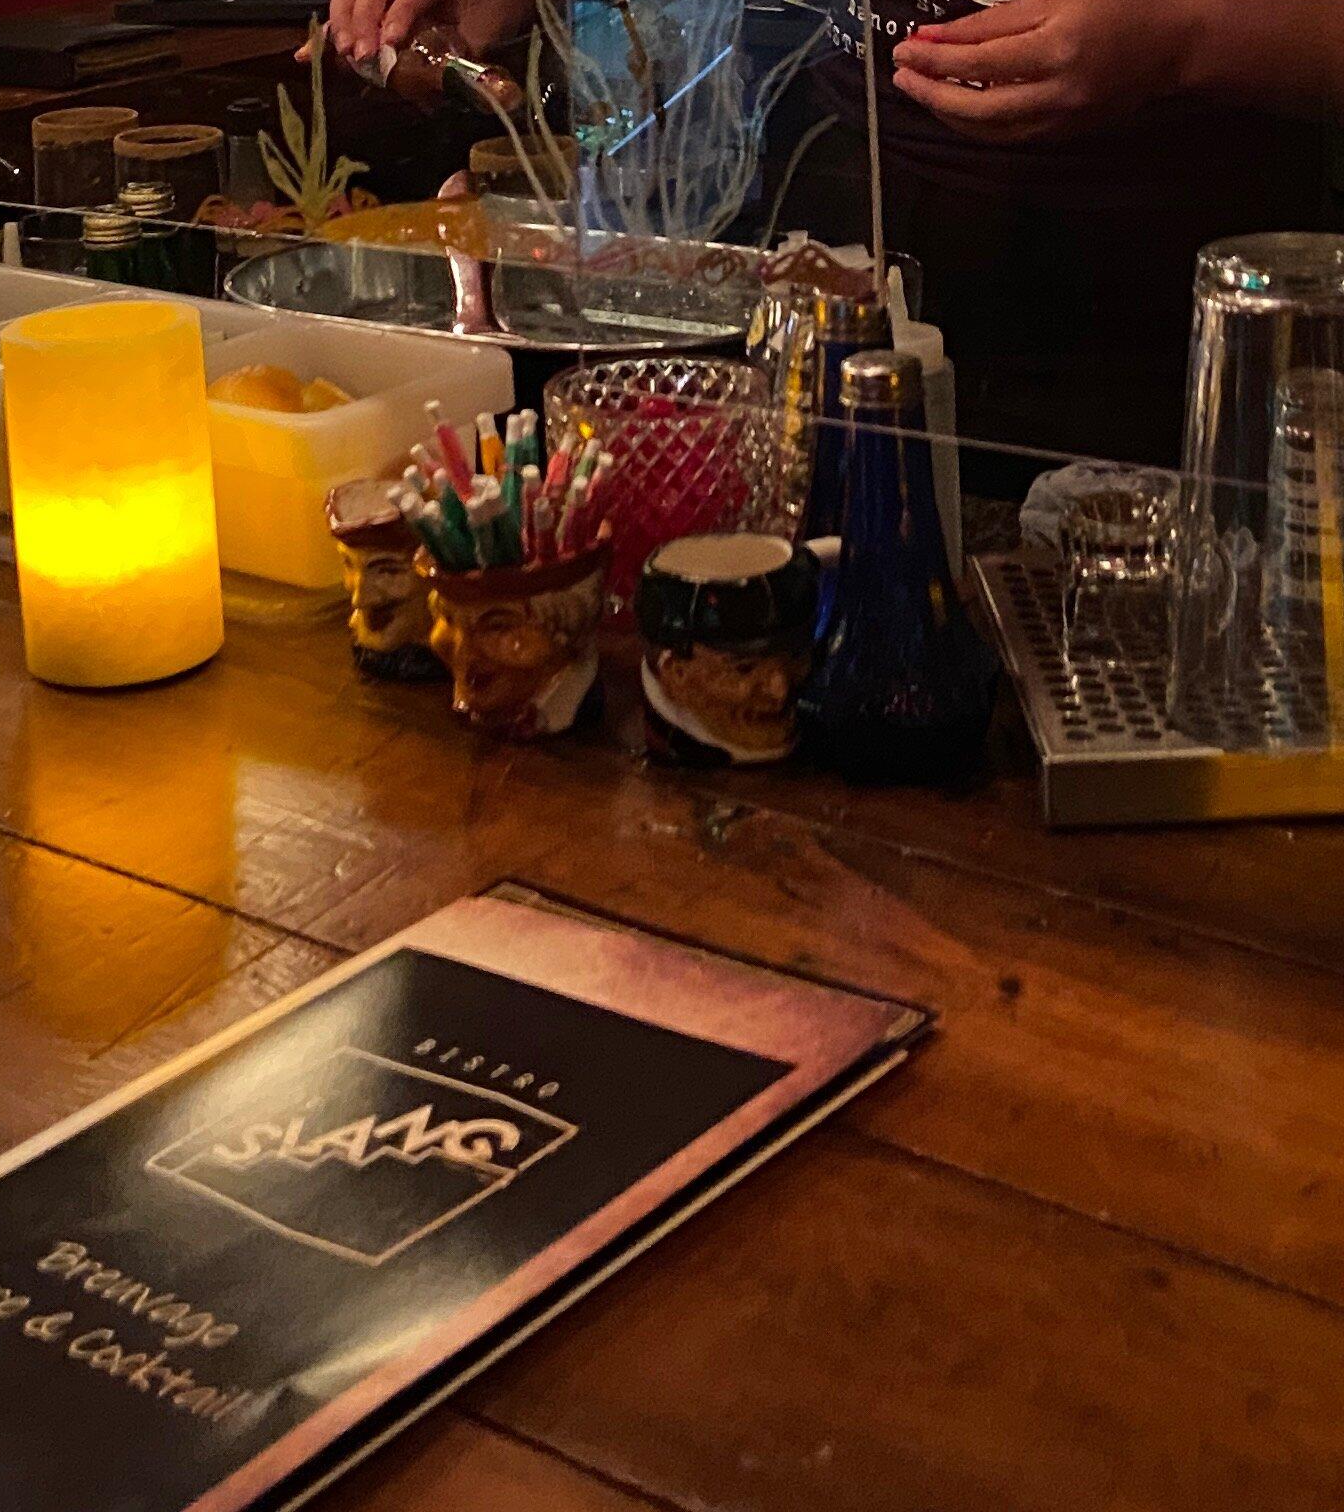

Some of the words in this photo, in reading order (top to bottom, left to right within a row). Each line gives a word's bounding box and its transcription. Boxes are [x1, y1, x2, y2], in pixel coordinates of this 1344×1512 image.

[414, 1038, 560, 1099] BISTRO
[36, 1241, 240, 1348] Breuvage
[23, 1311, 74, 1341] &
